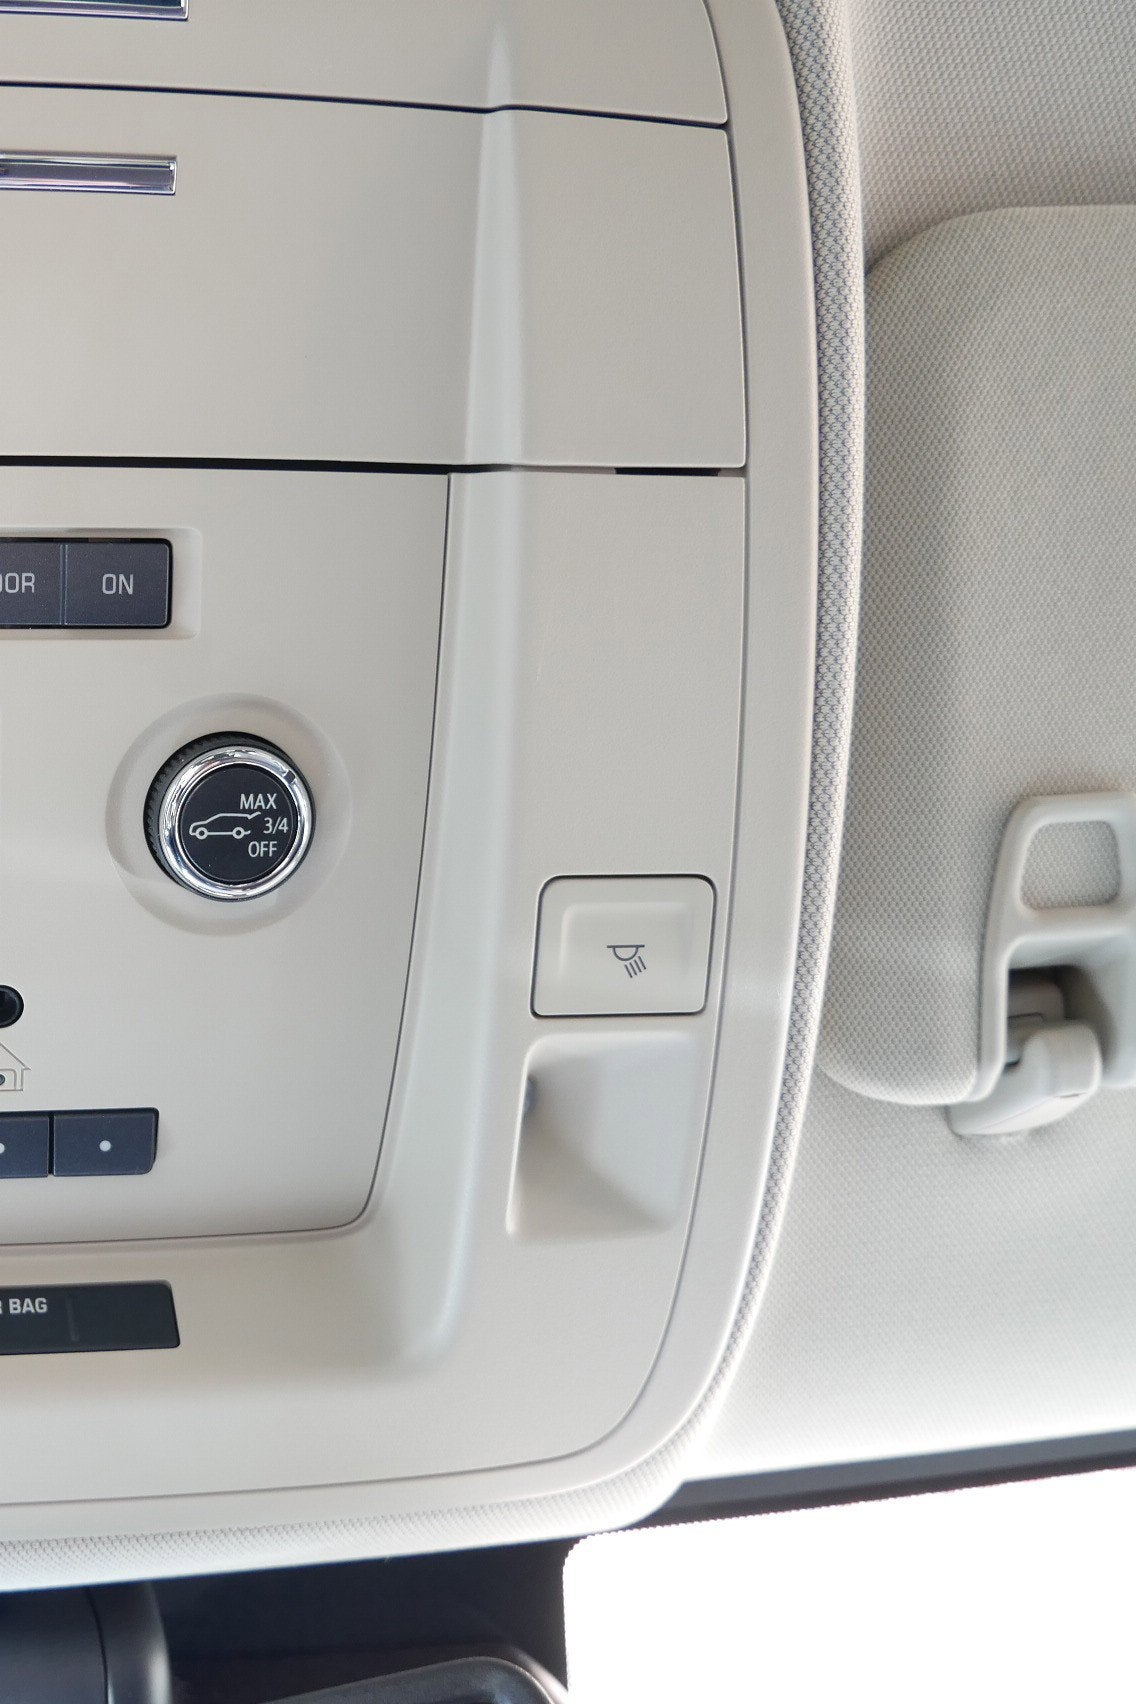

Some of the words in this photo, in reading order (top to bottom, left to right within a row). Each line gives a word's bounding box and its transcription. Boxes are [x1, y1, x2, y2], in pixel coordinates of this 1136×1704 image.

[102, 573, 134, 595] ON
[239, 793, 277, 810] MAX
[263, 816, 289, 835] 3/4
[248, 841, 278, 858] OFF
[8, 1298, 48, 1314] BAG
